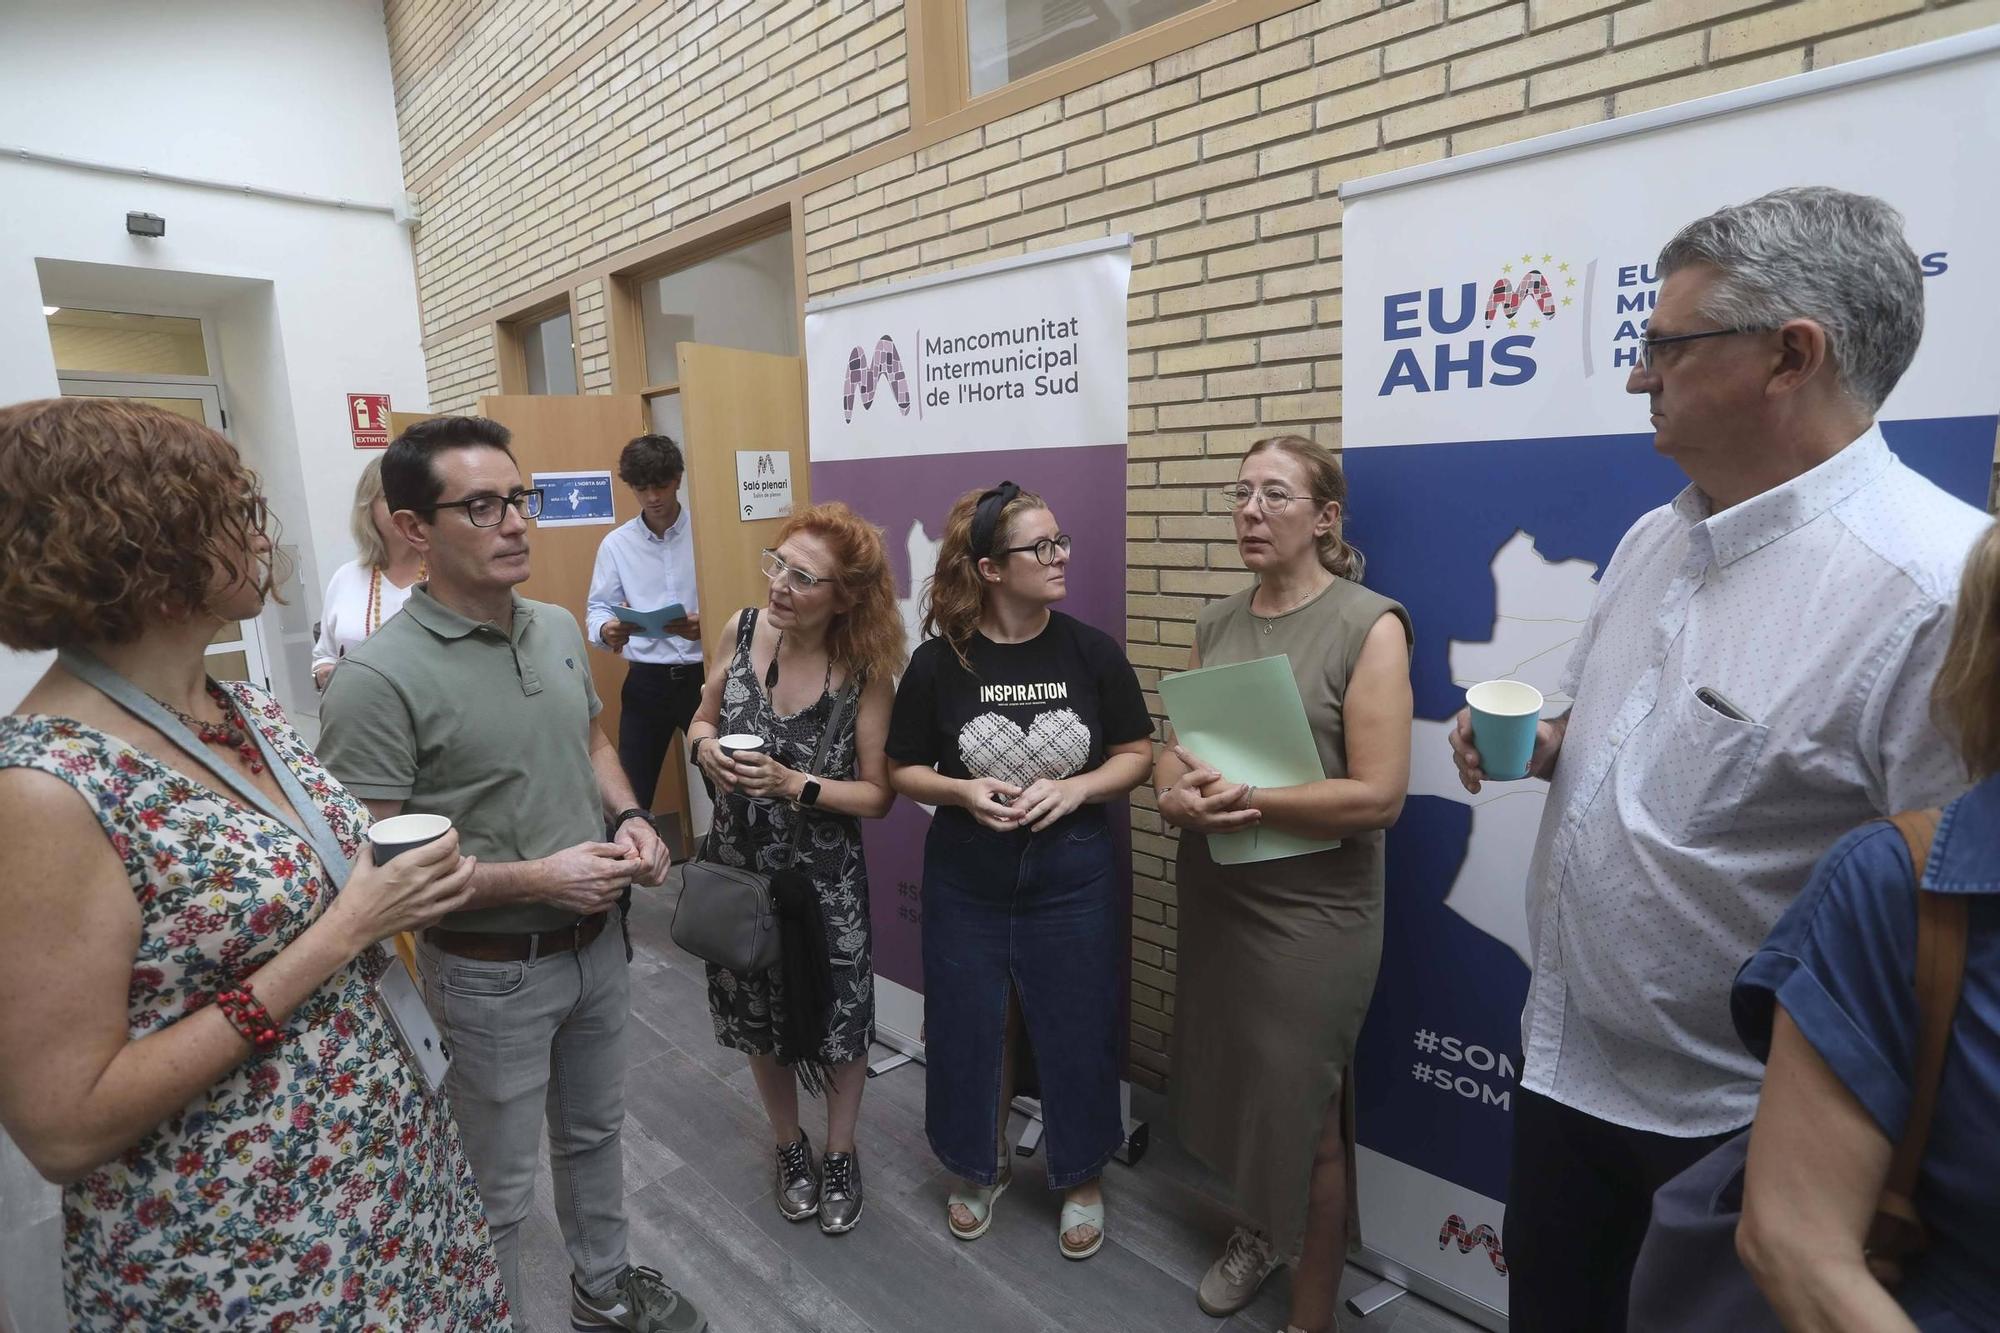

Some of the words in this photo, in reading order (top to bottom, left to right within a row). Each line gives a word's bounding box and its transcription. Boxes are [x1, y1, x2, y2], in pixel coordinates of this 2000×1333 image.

[1618, 264, 1660, 287] EU
[926, 317, 1079, 357] Mancomunitat
[926, 343, 1078, 382] Intermunicipal
[1378, 335, 1538, 396] AHS
[1614, 347, 1637, 368] H
[926, 387, 950, 407] de
[959, 381, 1024, 404] l'Horta
[1035, 371, 1079, 396] Sud
[743, 480, 760, 491] Saló
[762, 479, 788, 491] plenari
[980, 682, 1068, 703] INSPIRATION
[1412, 1062, 1511, 1112] #SOM
